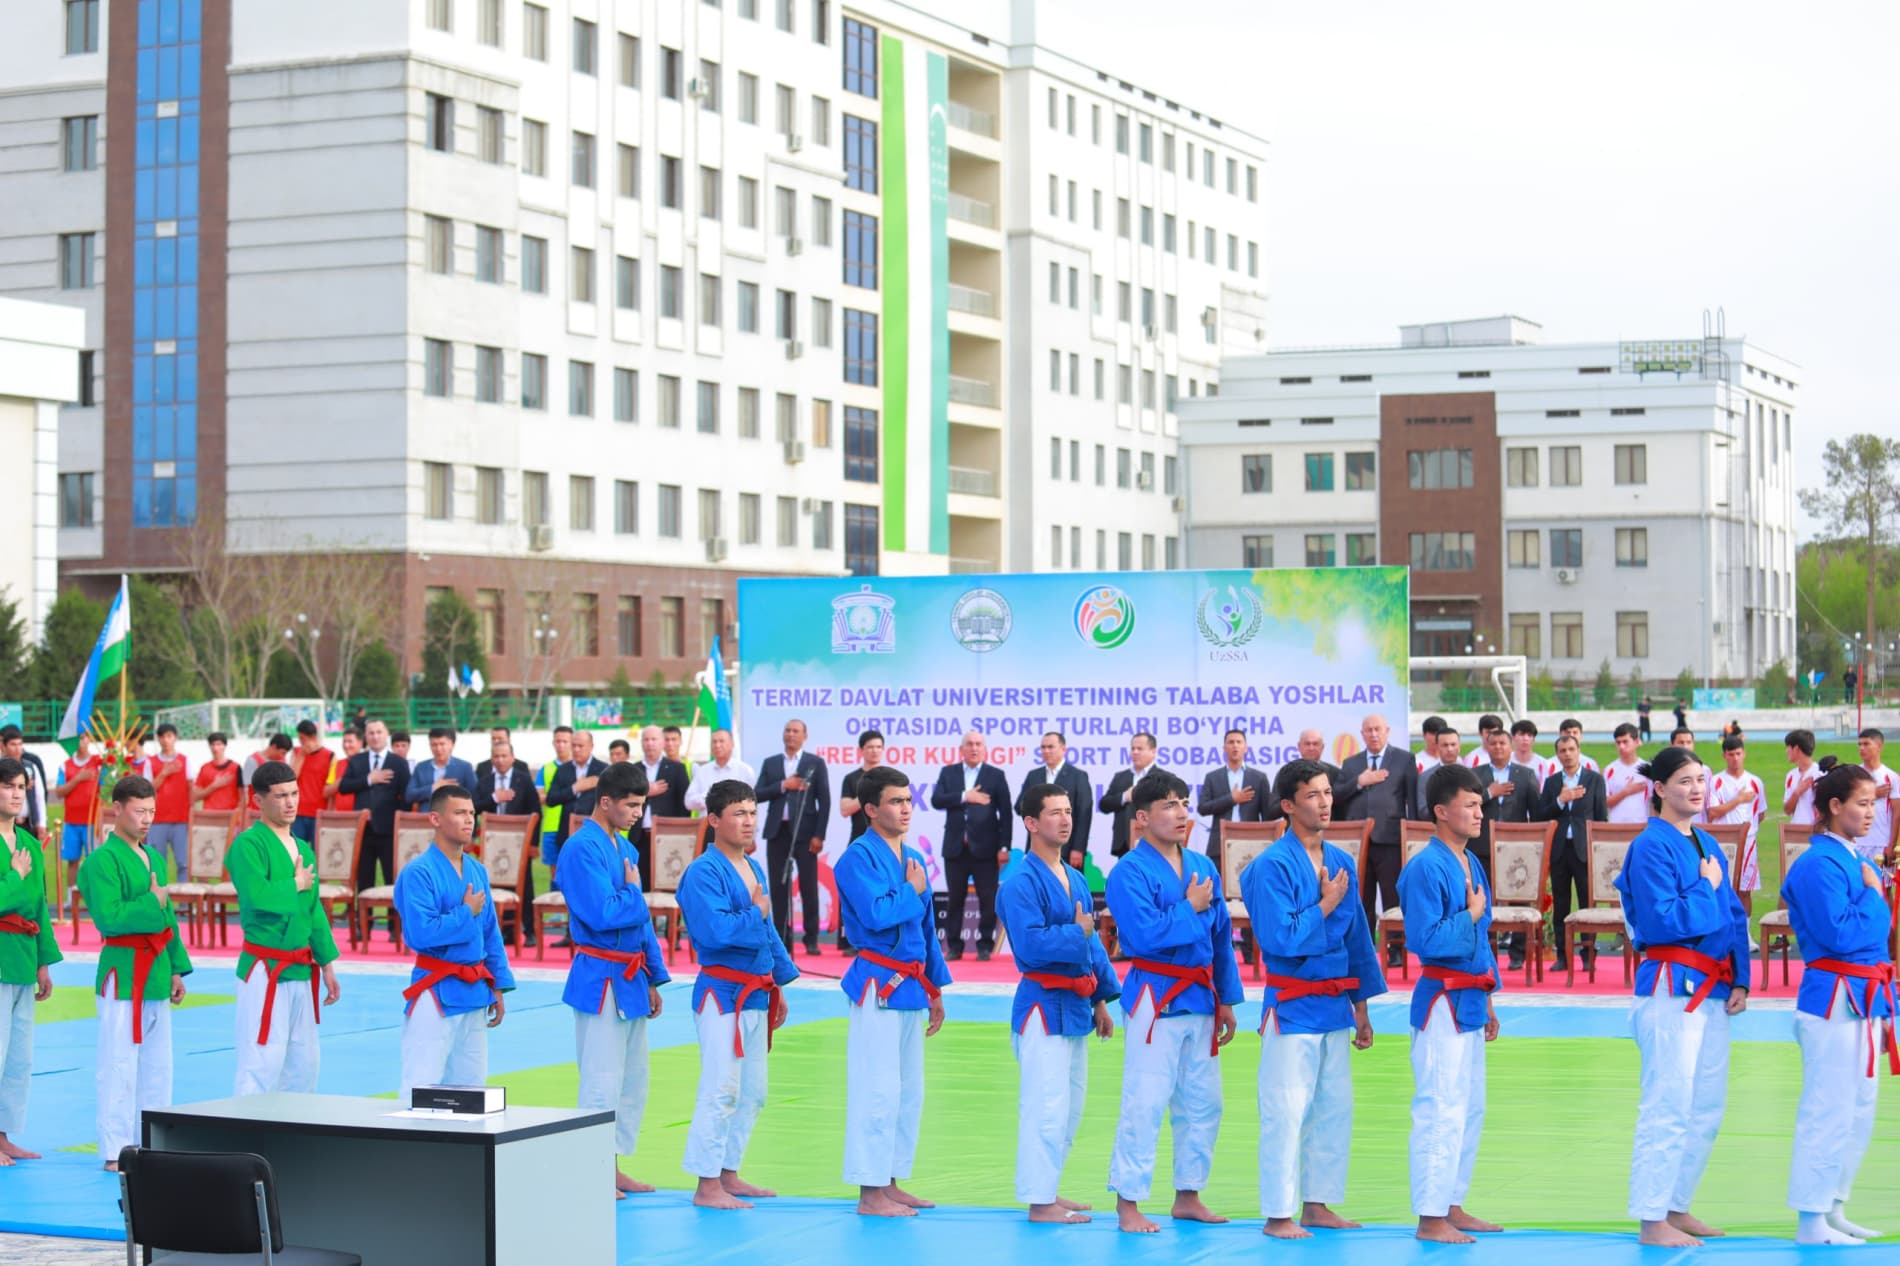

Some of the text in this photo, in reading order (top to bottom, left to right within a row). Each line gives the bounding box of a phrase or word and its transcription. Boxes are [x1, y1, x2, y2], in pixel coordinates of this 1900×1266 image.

[752, 685, 1384, 707] TERMIZ DAVLAT UNIVERSITETINING TALABA YOSHLAR
[971, 717, 1048, 735] SPORT
[1056, 717, 1158, 735] TURLARI
[1033, 747, 1111, 765] SORT
